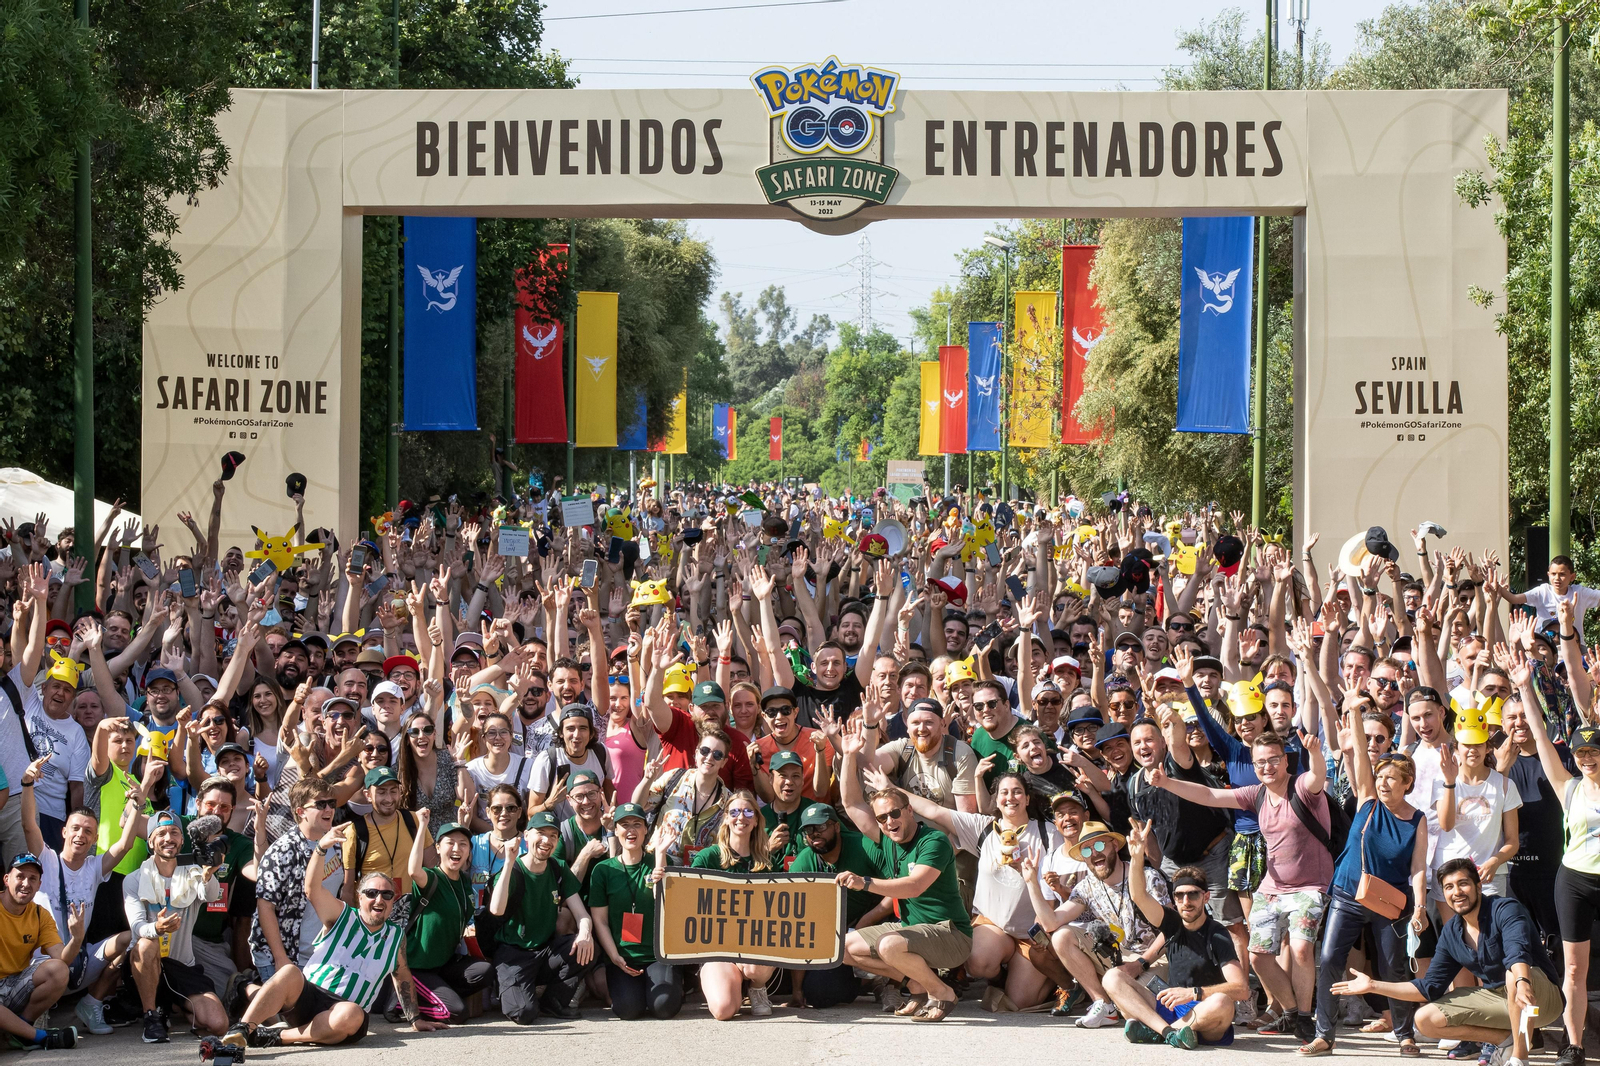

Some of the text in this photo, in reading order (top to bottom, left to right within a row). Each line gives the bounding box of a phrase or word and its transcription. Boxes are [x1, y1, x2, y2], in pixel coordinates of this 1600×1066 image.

[786, 106, 868, 148] GO
[416, 119, 724, 176] BIENVENIDOS
[925, 120, 1284, 177] ENTRENADORES
[770, 166, 888, 195] SAFARI ZONE
[207, 353, 279, 369] WELCOME TO
[1391, 356, 1426, 371] SPAIN
[156, 375, 328, 414] SAFARI ZONE
[1354, 380, 1464, 415] SEVILLA
[193, 417, 294, 428] #PokémonGOSafariZone
[1360, 421, 1462, 429] #PokémonGOSafariZone
[697, 888, 807, 919] MEET YOU
[684, 916, 816, 949] OUT THERE!
